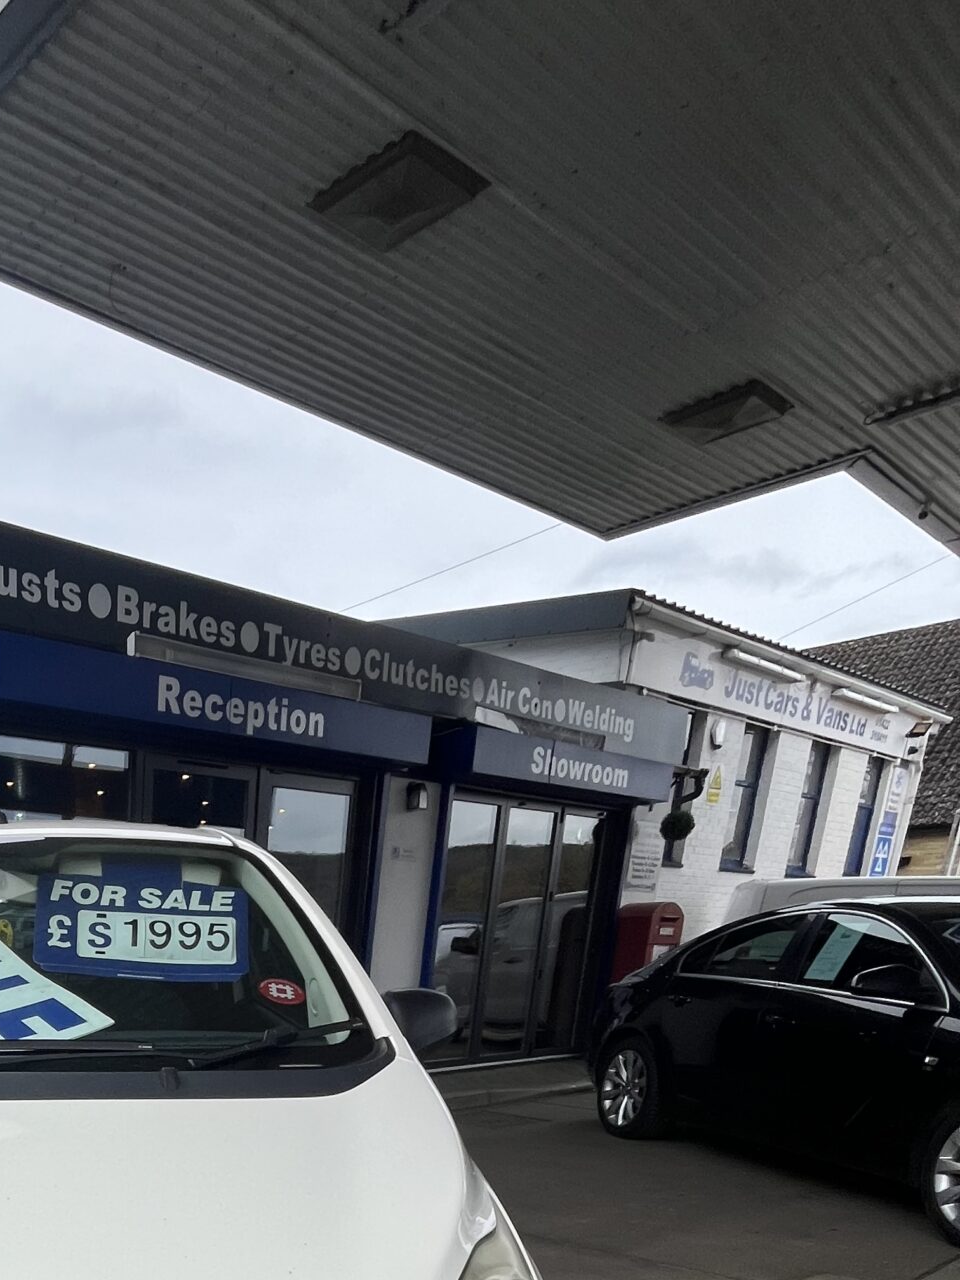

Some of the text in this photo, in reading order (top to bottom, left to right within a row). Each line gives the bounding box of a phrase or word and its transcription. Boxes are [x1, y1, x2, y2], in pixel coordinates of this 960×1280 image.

[116, 584, 236, 648] Brakes
[263, 622, 341, 671] Tyres
[364, 648, 470, 699] Clutches
[486, 678, 515, 710] Air
[518, 687, 552, 722] Con
[568, 699, 635, 743] Welding
[157, 675, 325, 738] Reception
[724, 671, 765, 708] Just
[764, 681, 798, 718] Cars
[800, 693, 813, 721] &
[816, 699, 850, 732] Vans
[849, 718, 869, 738] Ltd
[531, 746, 629, 788] Showroom
[50, 879, 235, 912] FOR SALE
